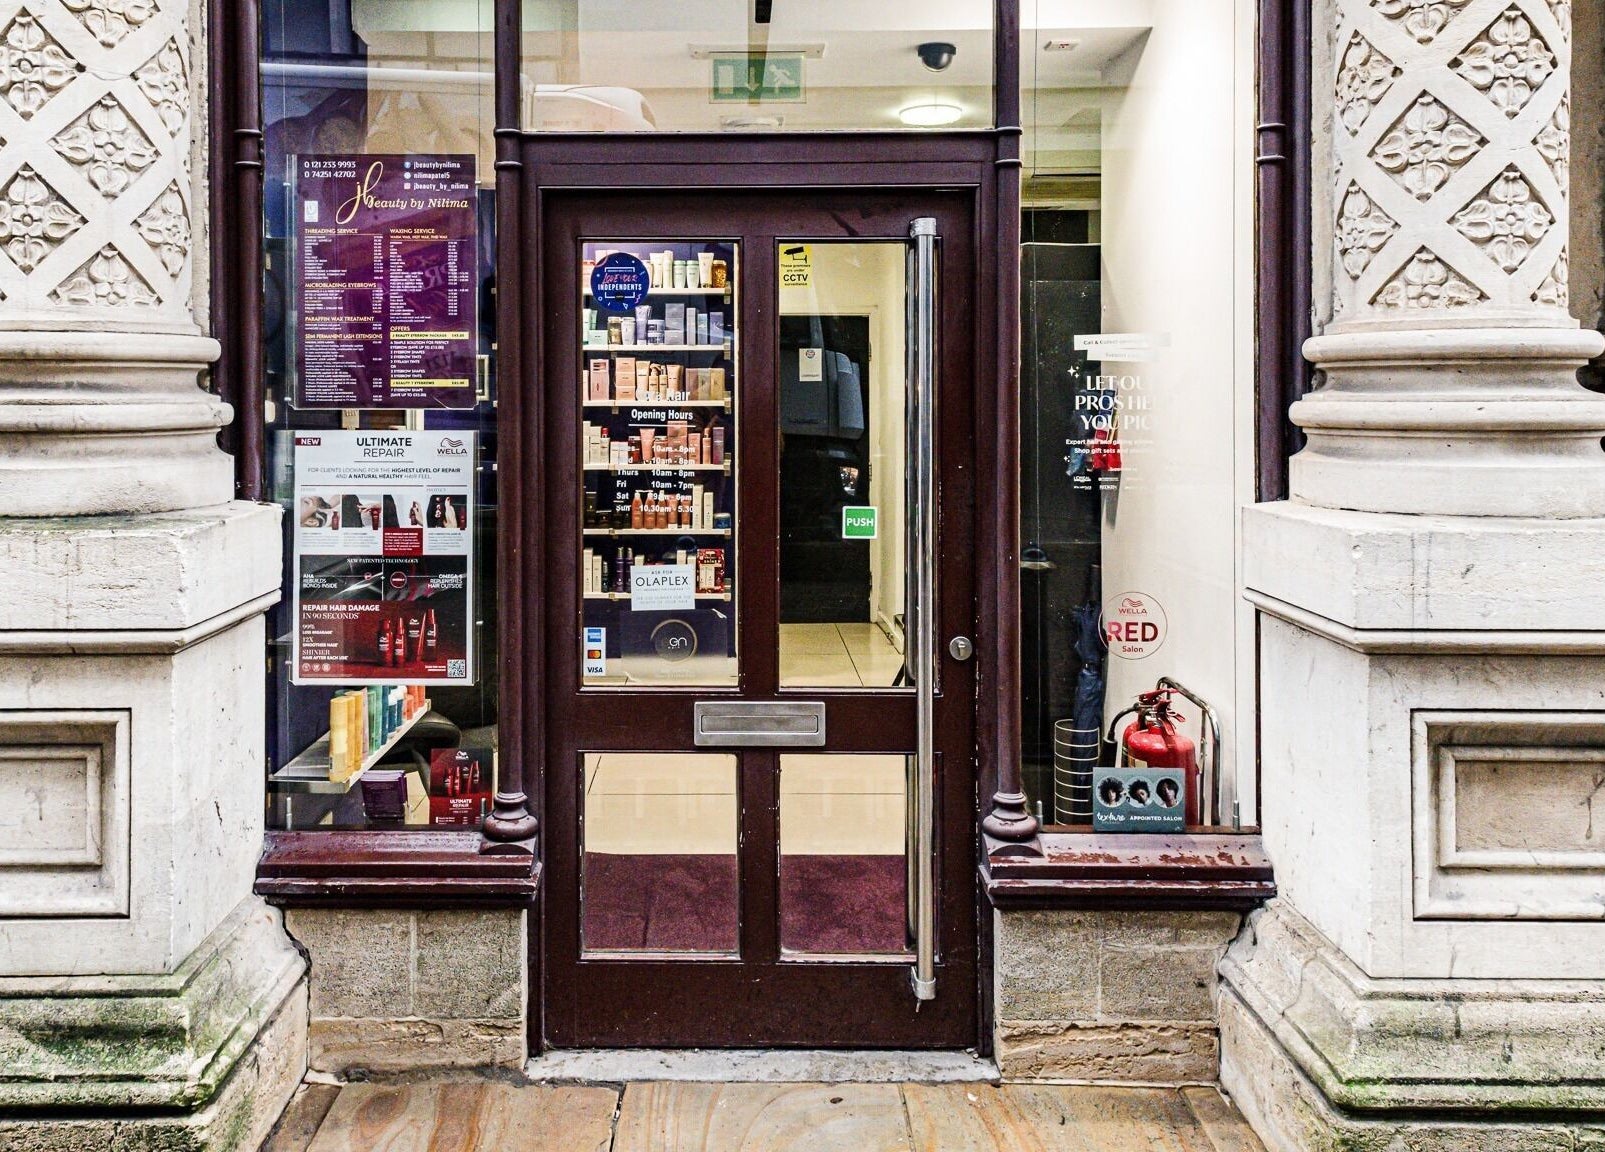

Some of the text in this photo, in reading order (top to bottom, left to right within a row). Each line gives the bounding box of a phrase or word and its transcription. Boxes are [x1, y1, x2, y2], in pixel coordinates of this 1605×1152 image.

[410, 198, 425, 210] by
[428, 198, 469, 208] Nilima
[783, 273, 809, 282] CCTV
[597, 283, 642, 291] INDEPENDENTS
[1086, 375, 1115, 391] LET
[1075, 394, 1124, 411] PROS
[631, 408, 694, 422] Opening Hours
[1080, 414, 1120, 430] YOU
[356, 437, 412, 447] ULTIMATE
[363, 447, 405, 457] REPAIR
[678, 470, 695, 478] 8pm
[616, 480, 627, 488] Fri
[678, 481, 695, 490] 7pm
[846, 517, 874, 527] PUSH
[635, 576, 689, 587] OLAPLEX
[1107, 621, 1159, 642] RED
[1122, 645, 1144, 653] Salon
